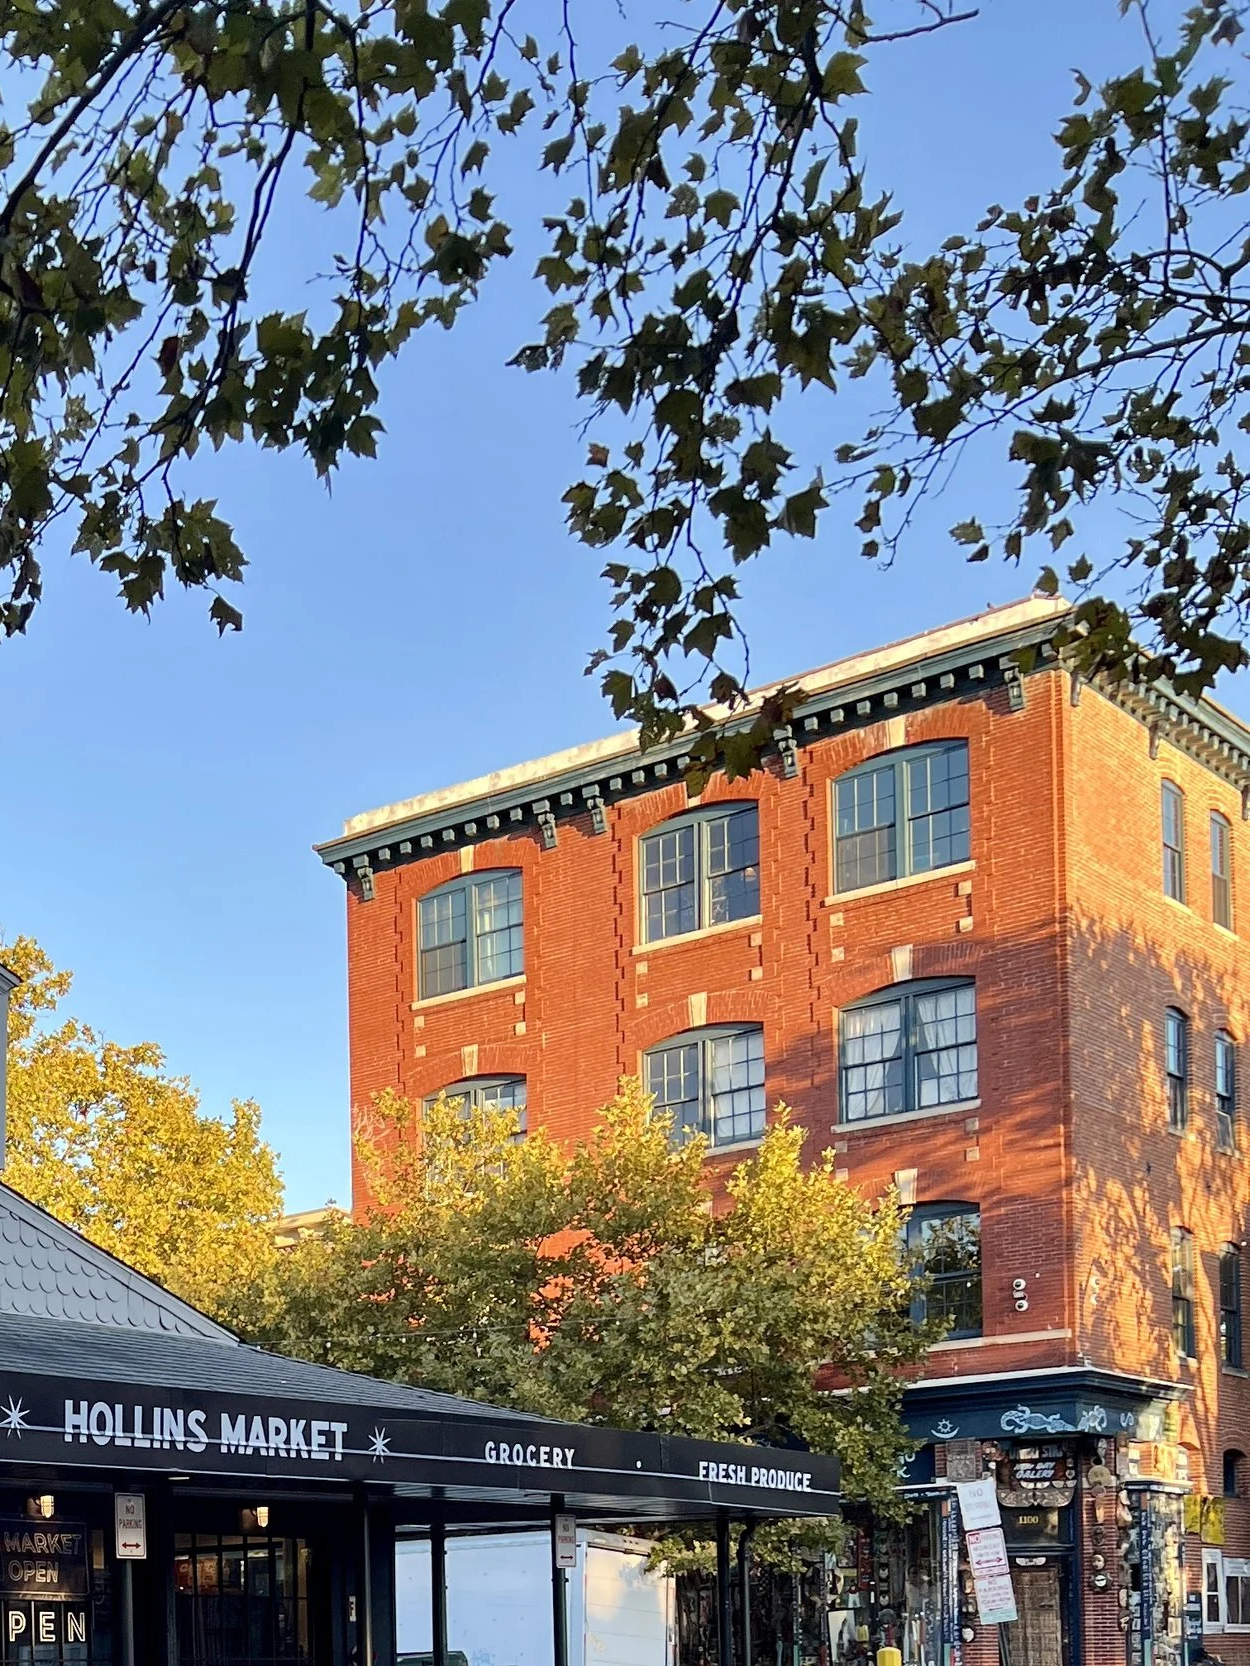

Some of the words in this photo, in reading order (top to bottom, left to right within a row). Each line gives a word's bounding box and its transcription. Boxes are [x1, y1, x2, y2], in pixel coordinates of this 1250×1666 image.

[63, 1398, 209, 1453] HOLLINS
[218, 1411, 349, 1462] MARKET
[484, 1439, 577, 1470] GROCERY
[699, 1461, 746, 1485] FRESH
[751, 1466, 812, 1493] PRODUCE
[125, 1504, 135, 1515] NO
[1017, 1515, 1039, 1525] 1100
[119, 1518, 142, 1529] PARKING
[3, 1530, 83, 1556] MARKET
[7, 1559, 60, 1584] OPEN
